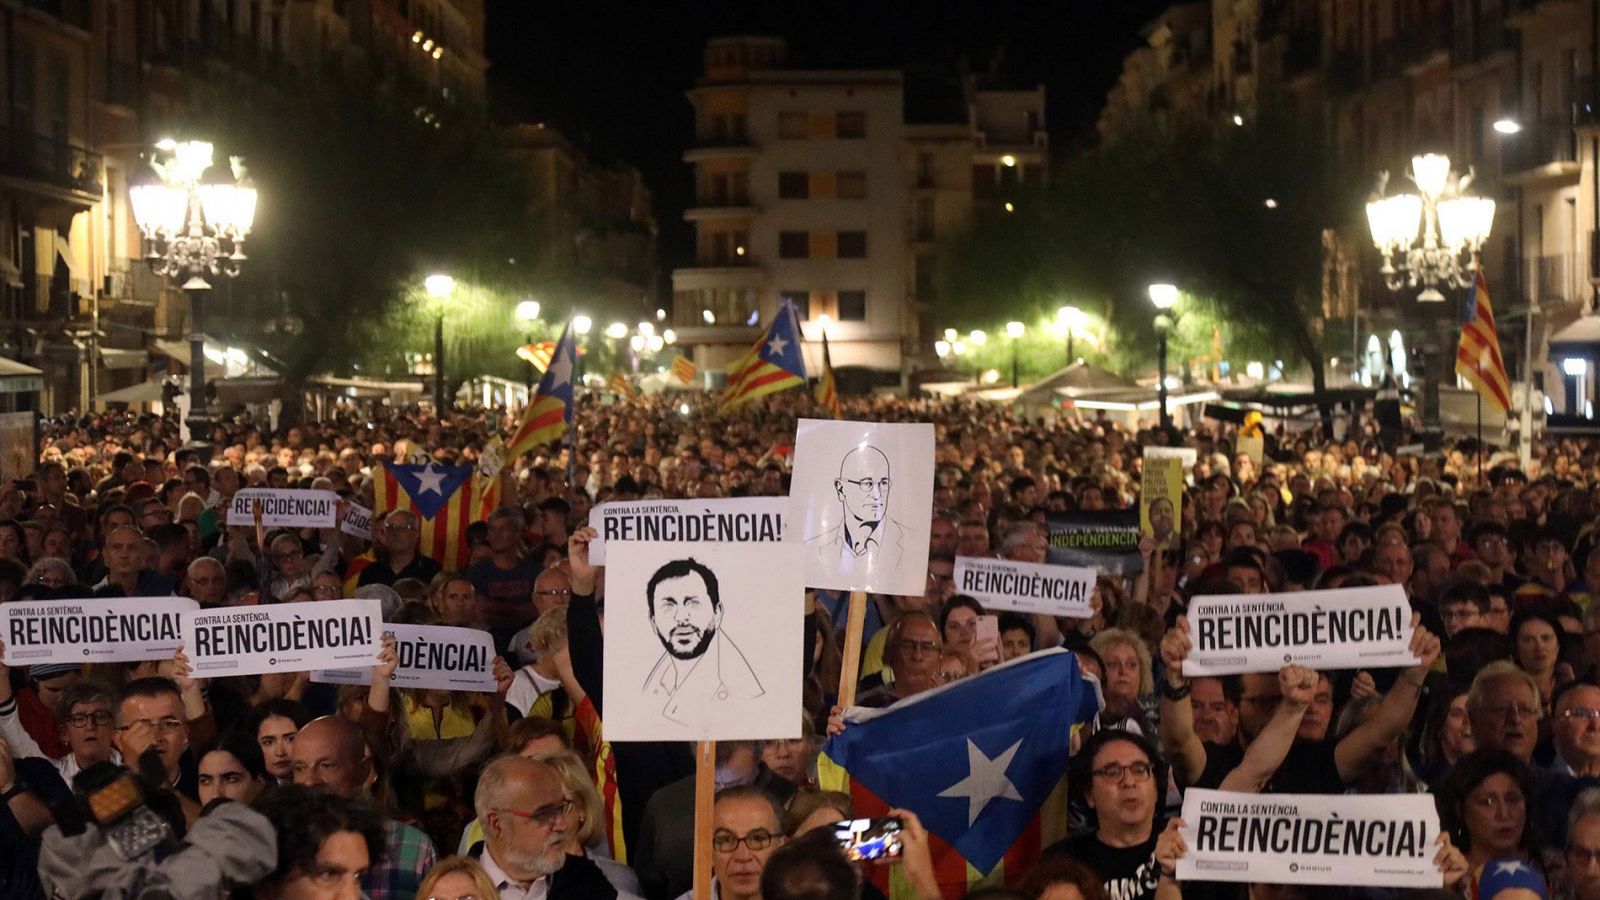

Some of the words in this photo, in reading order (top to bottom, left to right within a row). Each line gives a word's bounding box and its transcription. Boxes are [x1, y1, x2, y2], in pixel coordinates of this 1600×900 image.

[235, 496, 330, 516] RENCIDÈNCIA!
[604, 507, 630, 516] CONTRA
[632, 506, 640, 514] LA
[604, 509, 782, 542] REINCIDÈNCIA!
[963, 572, 1087, 602] REINCIDÈNCIA!
[9, 608, 36, 616] CONTRA
[37, 607, 45, 616] LA
[194, 616, 221, 626] CONTRA
[222, 615, 232, 624] LA
[1198, 605, 1229, 616] CONTRA
[1230, 604, 1240, 614] LA
[10, 610, 182, 646] REINCIDÈNCIA!
[195, 614, 372, 657] REINCIDÈNCIA!
[1198, 605, 1402, 651] REINCIDÈNCIA!
[1200, 802, 1236, 814] CONTRA
[1237, 803, 1248, 815] LA
[1196, 812, 1426, 858] REINCIDÈNCIA!
